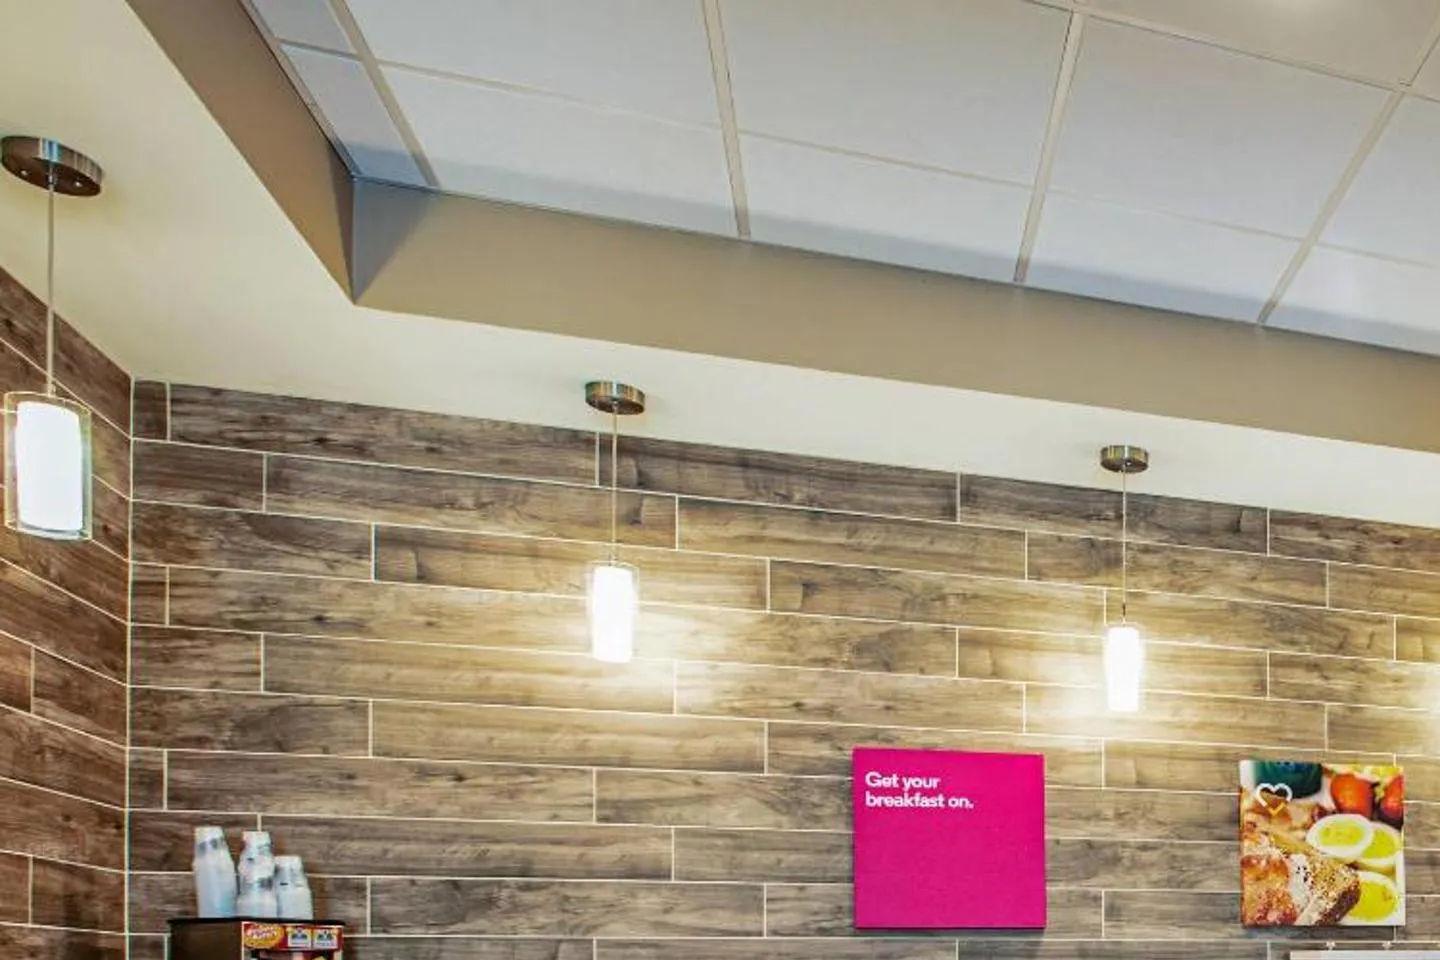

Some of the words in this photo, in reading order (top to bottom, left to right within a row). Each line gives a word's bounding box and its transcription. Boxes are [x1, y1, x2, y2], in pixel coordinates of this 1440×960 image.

[865, 771, 899, 788] Get
[902, 776, 940, 792] your
[865, 791, 944, 808] breakfast
[948, 798, 974, 809] on.
